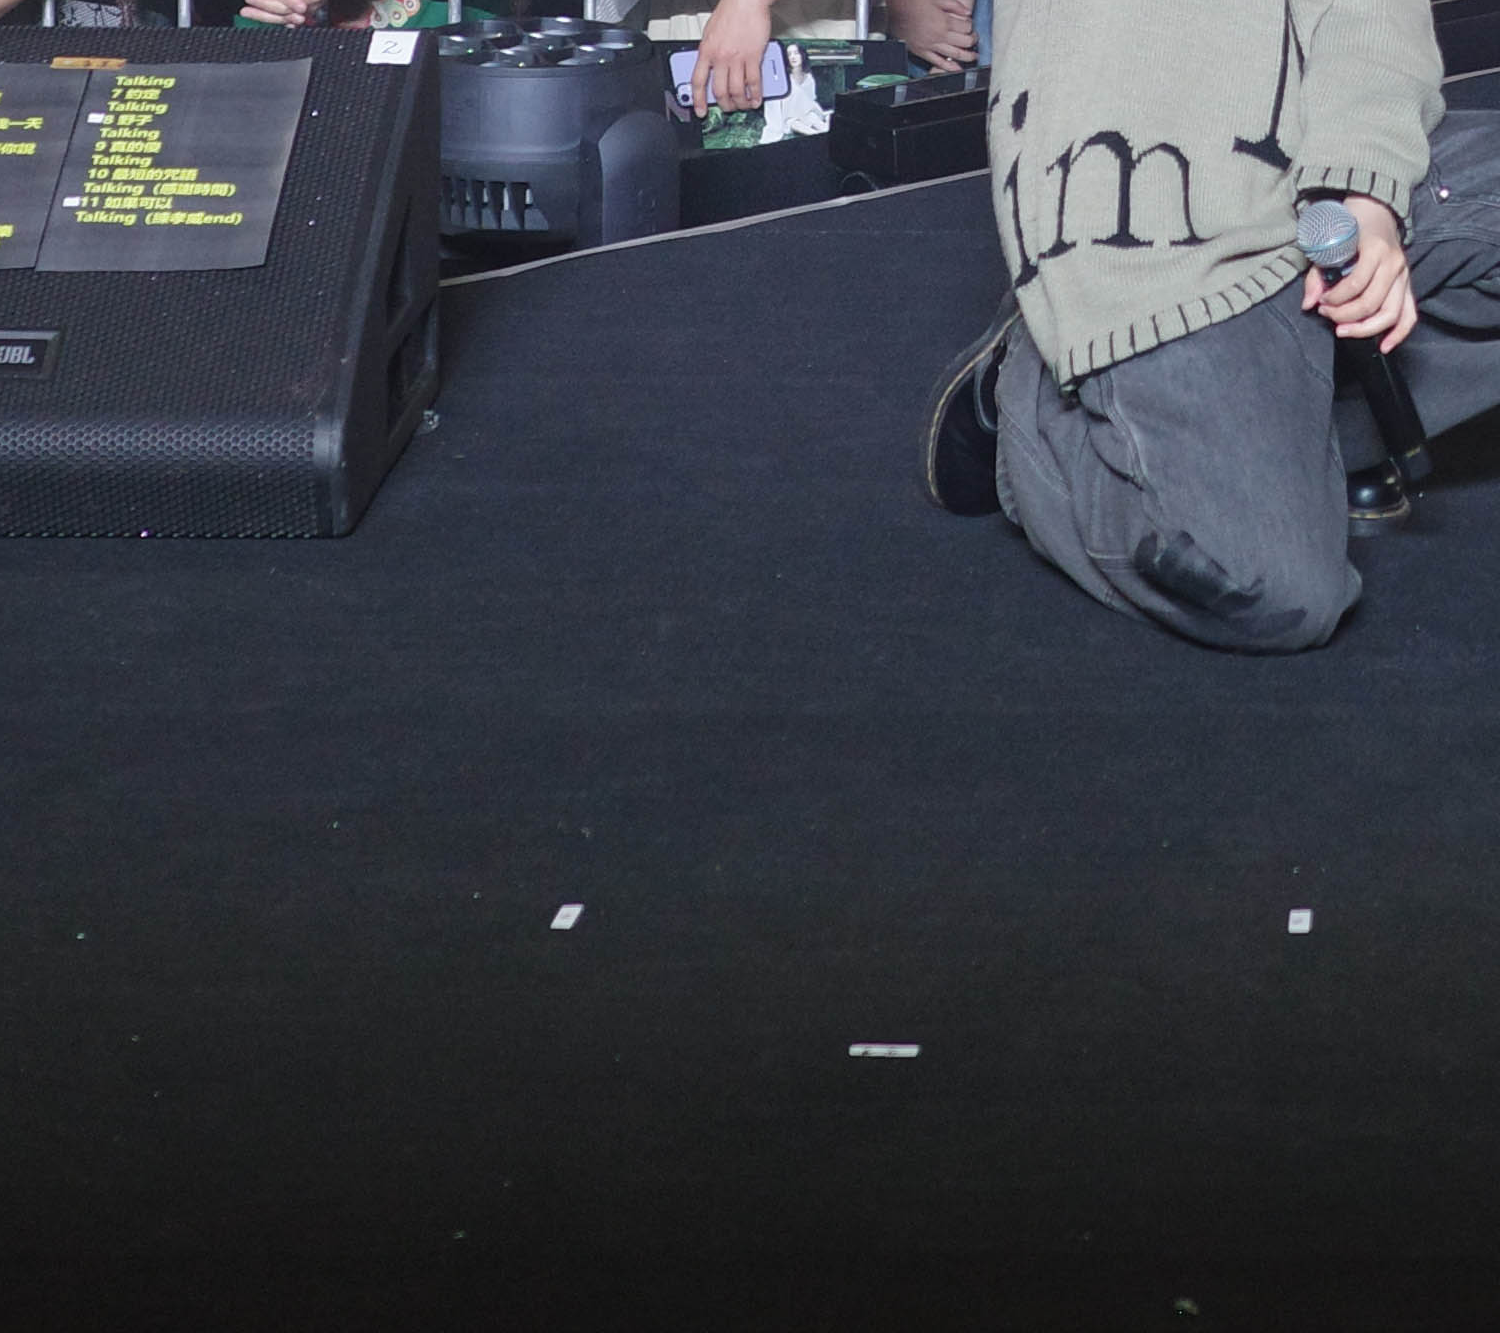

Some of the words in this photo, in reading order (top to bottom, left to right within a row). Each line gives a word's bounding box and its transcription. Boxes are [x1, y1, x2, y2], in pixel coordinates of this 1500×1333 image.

[116, 76, 175, 89] Talking
[108, 102, 168, 114] Talking
[100, 128, 160, 141] Talking
[92, 155, 152, 168] Talking
[104, 196, 173, 210] 如果可以
